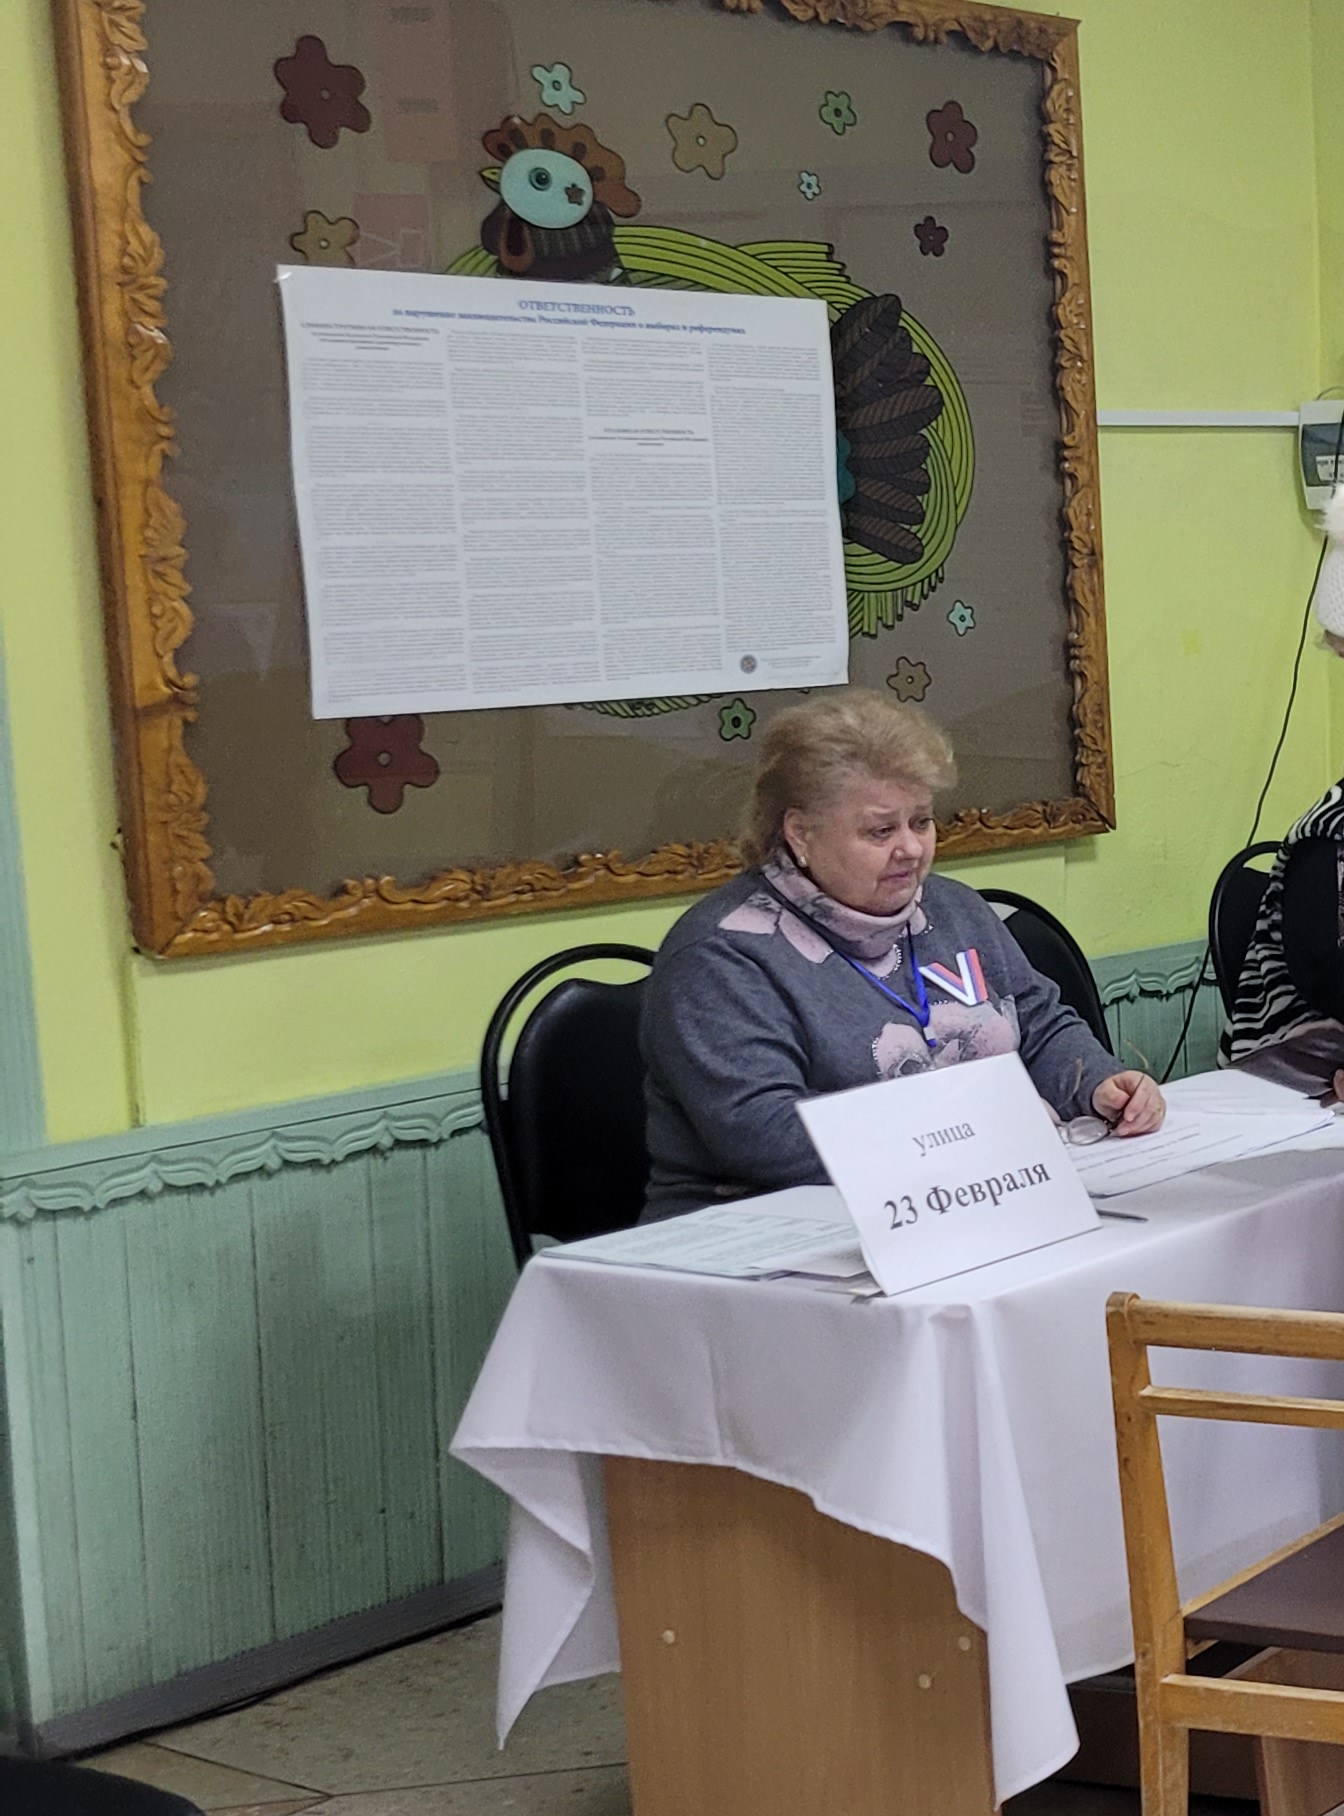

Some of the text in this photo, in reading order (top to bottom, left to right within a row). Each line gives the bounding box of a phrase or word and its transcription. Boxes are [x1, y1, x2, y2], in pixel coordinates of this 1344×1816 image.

[519, 300, 635, 316] ОТВЕТСТВЕННОСТЬ
[912, 1122, 976, 1157] улица
[884, 1163, 1051, 1230] 23 Февраля
